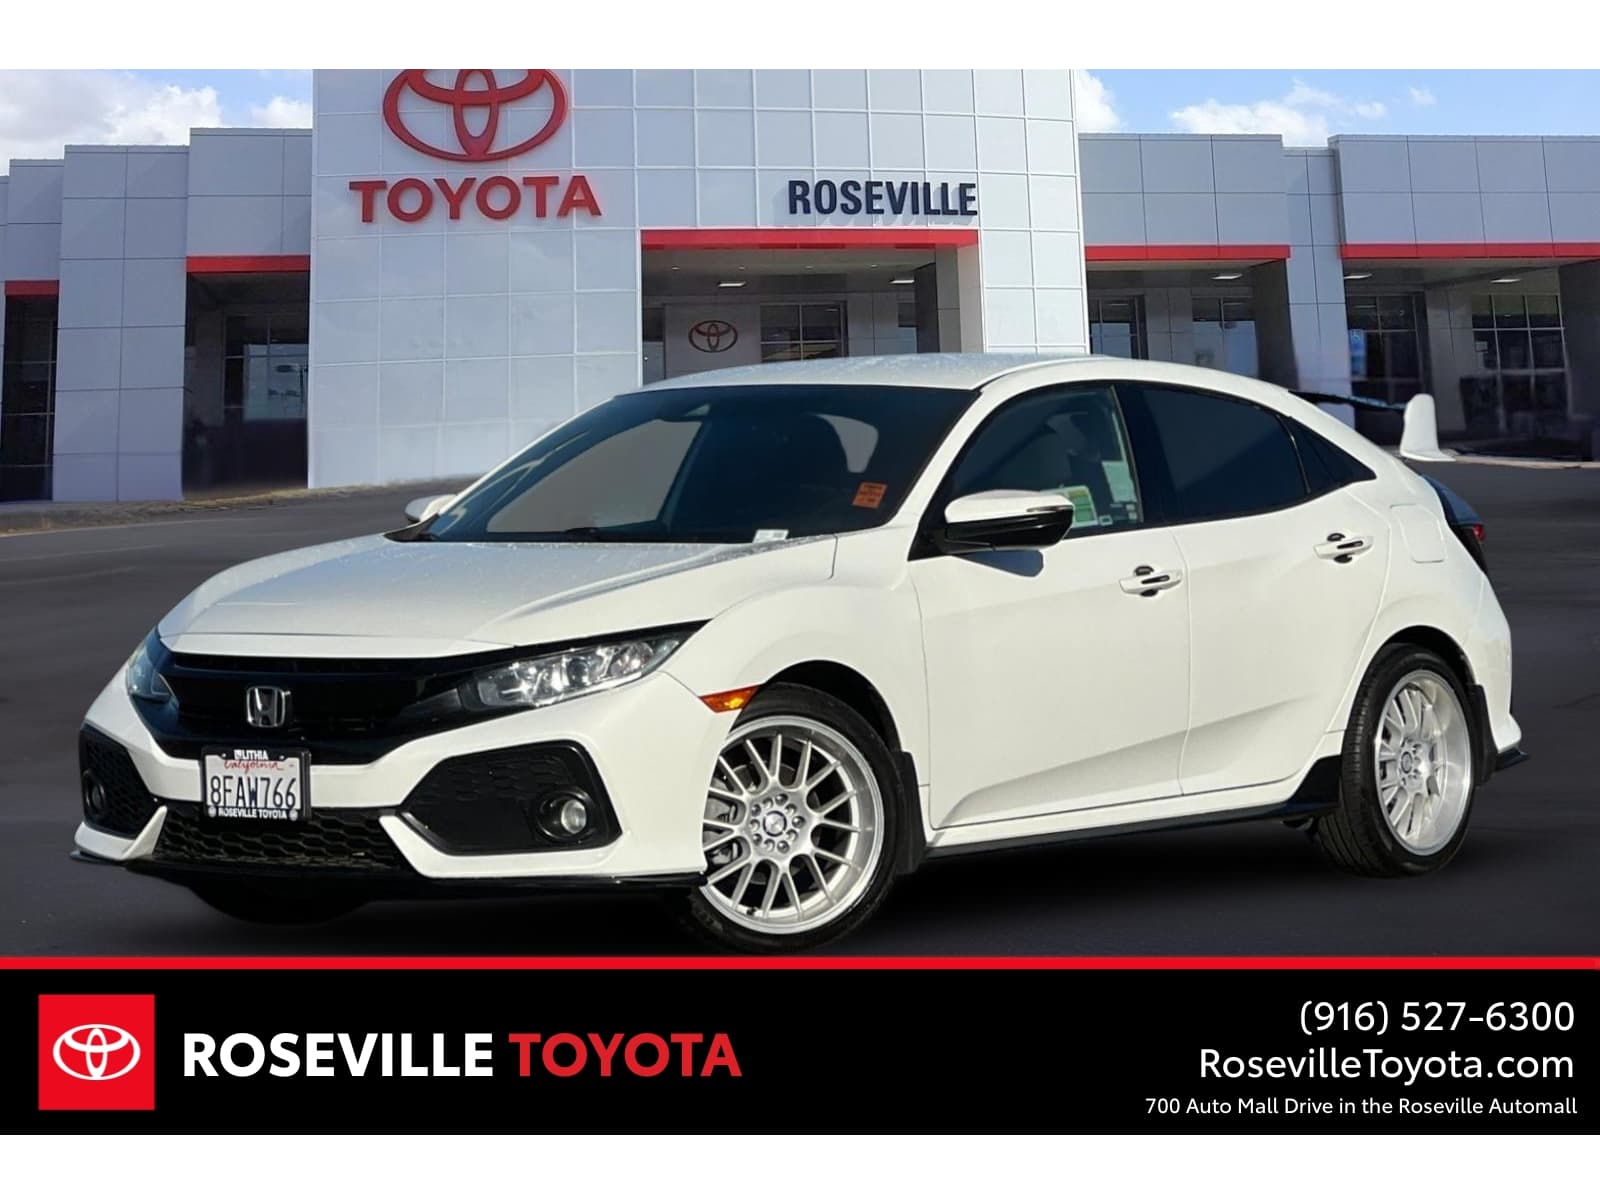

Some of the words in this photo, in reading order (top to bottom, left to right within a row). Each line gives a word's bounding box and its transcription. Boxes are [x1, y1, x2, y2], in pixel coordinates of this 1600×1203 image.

[348, 175, 602, 223] TOYOTA
[788, 180, 978, 216] ROSEVILLE
[241, 750, 269, 761] LITHIA
[223, 760, 284, 774] California
[218, 808, 258, 819] ROSEVILLE
[259, 809, 288, 819] TOYOTA
